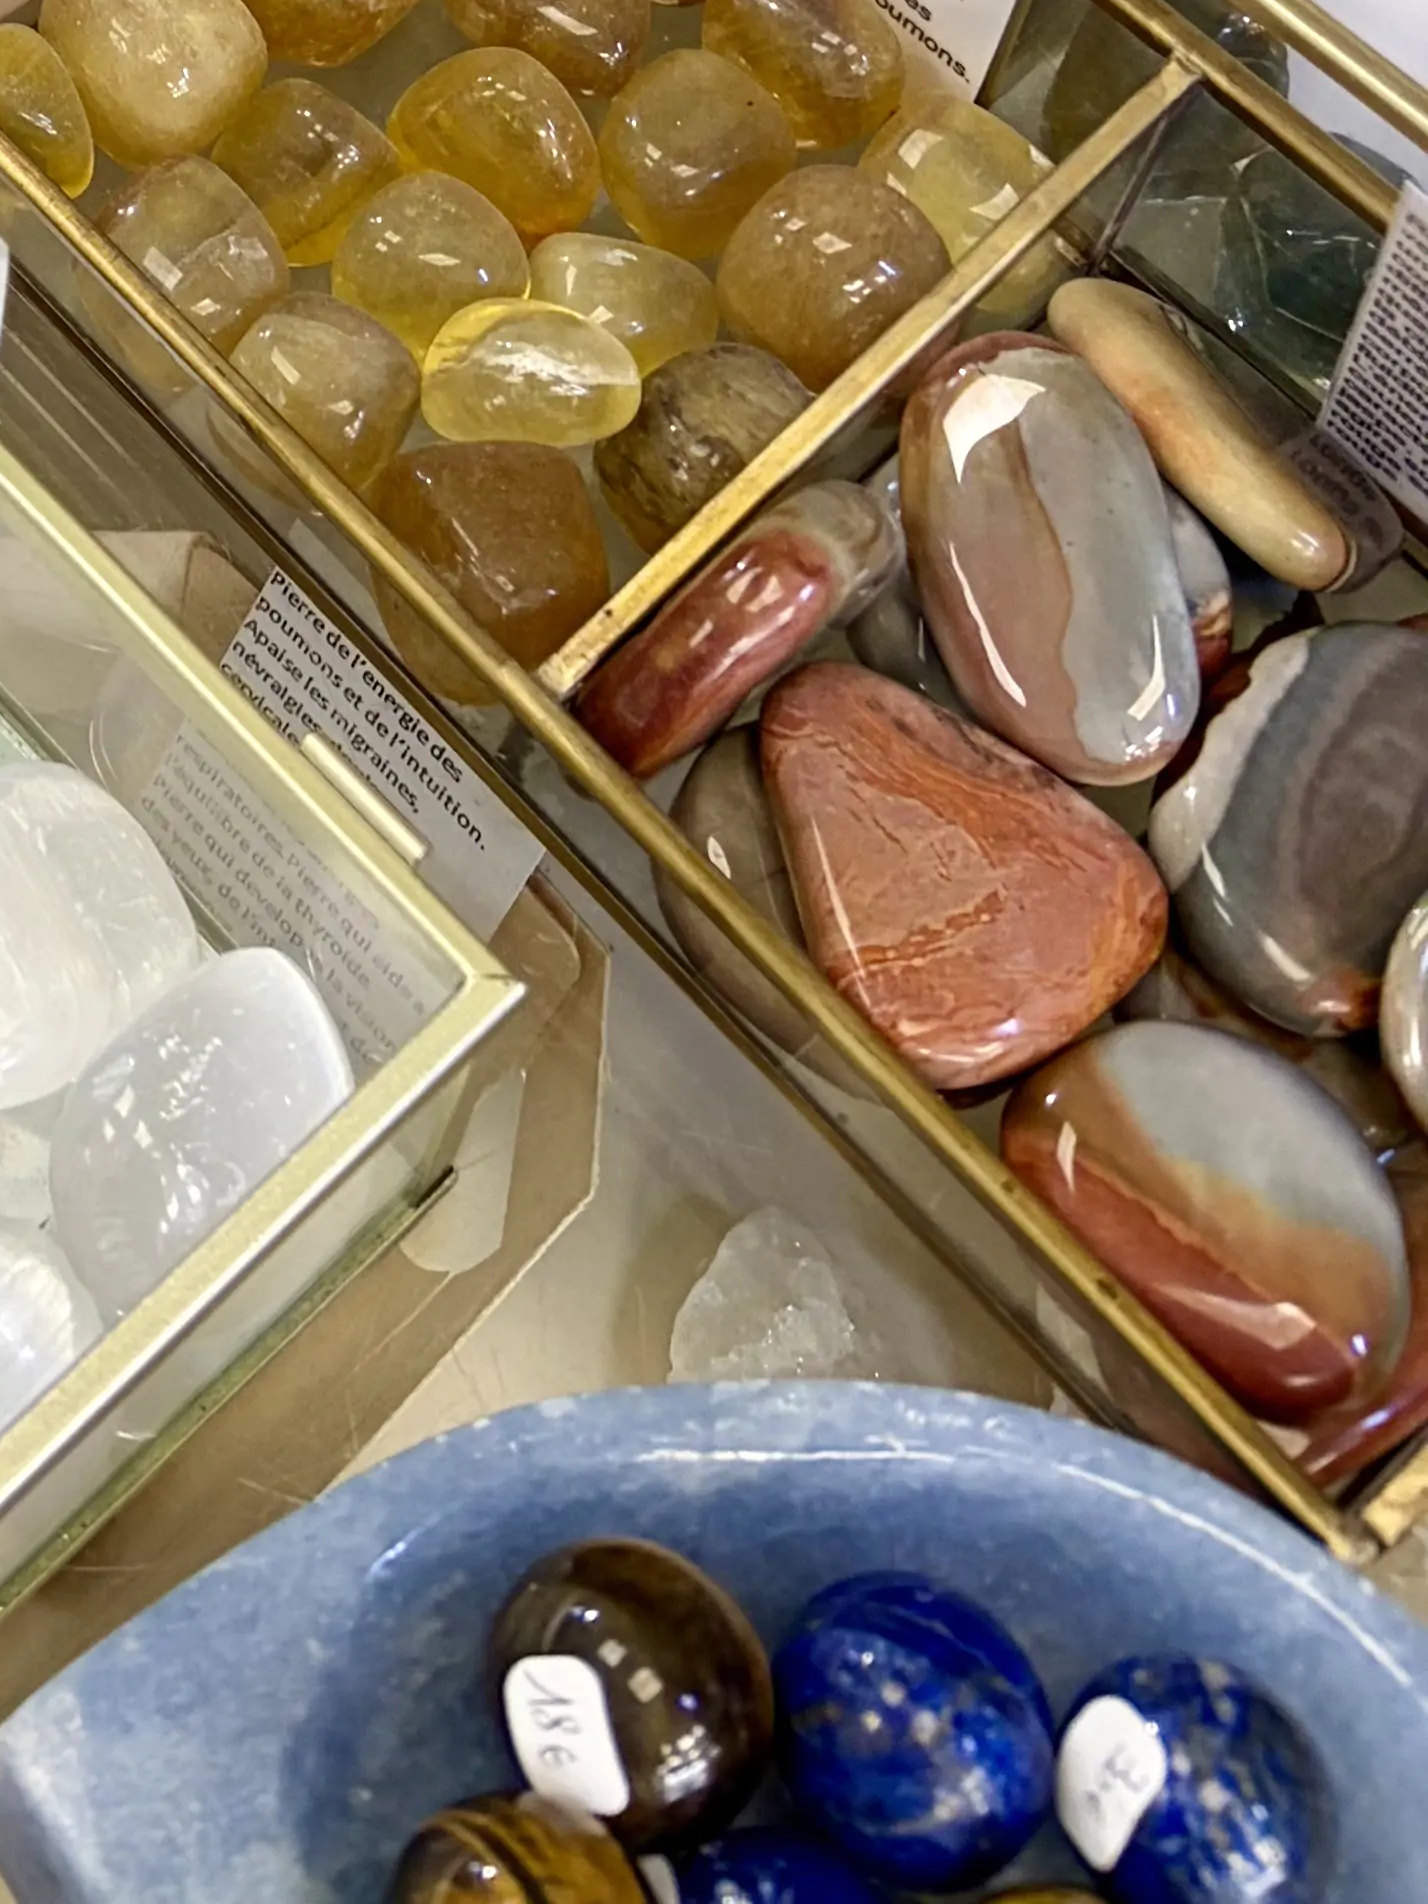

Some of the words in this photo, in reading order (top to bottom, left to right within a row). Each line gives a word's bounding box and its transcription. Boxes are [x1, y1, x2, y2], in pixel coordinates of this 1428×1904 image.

[270, 570, 326, 634] Pierre
[325, 631, 351, 660] de
[429, 744, 463, 783] des
